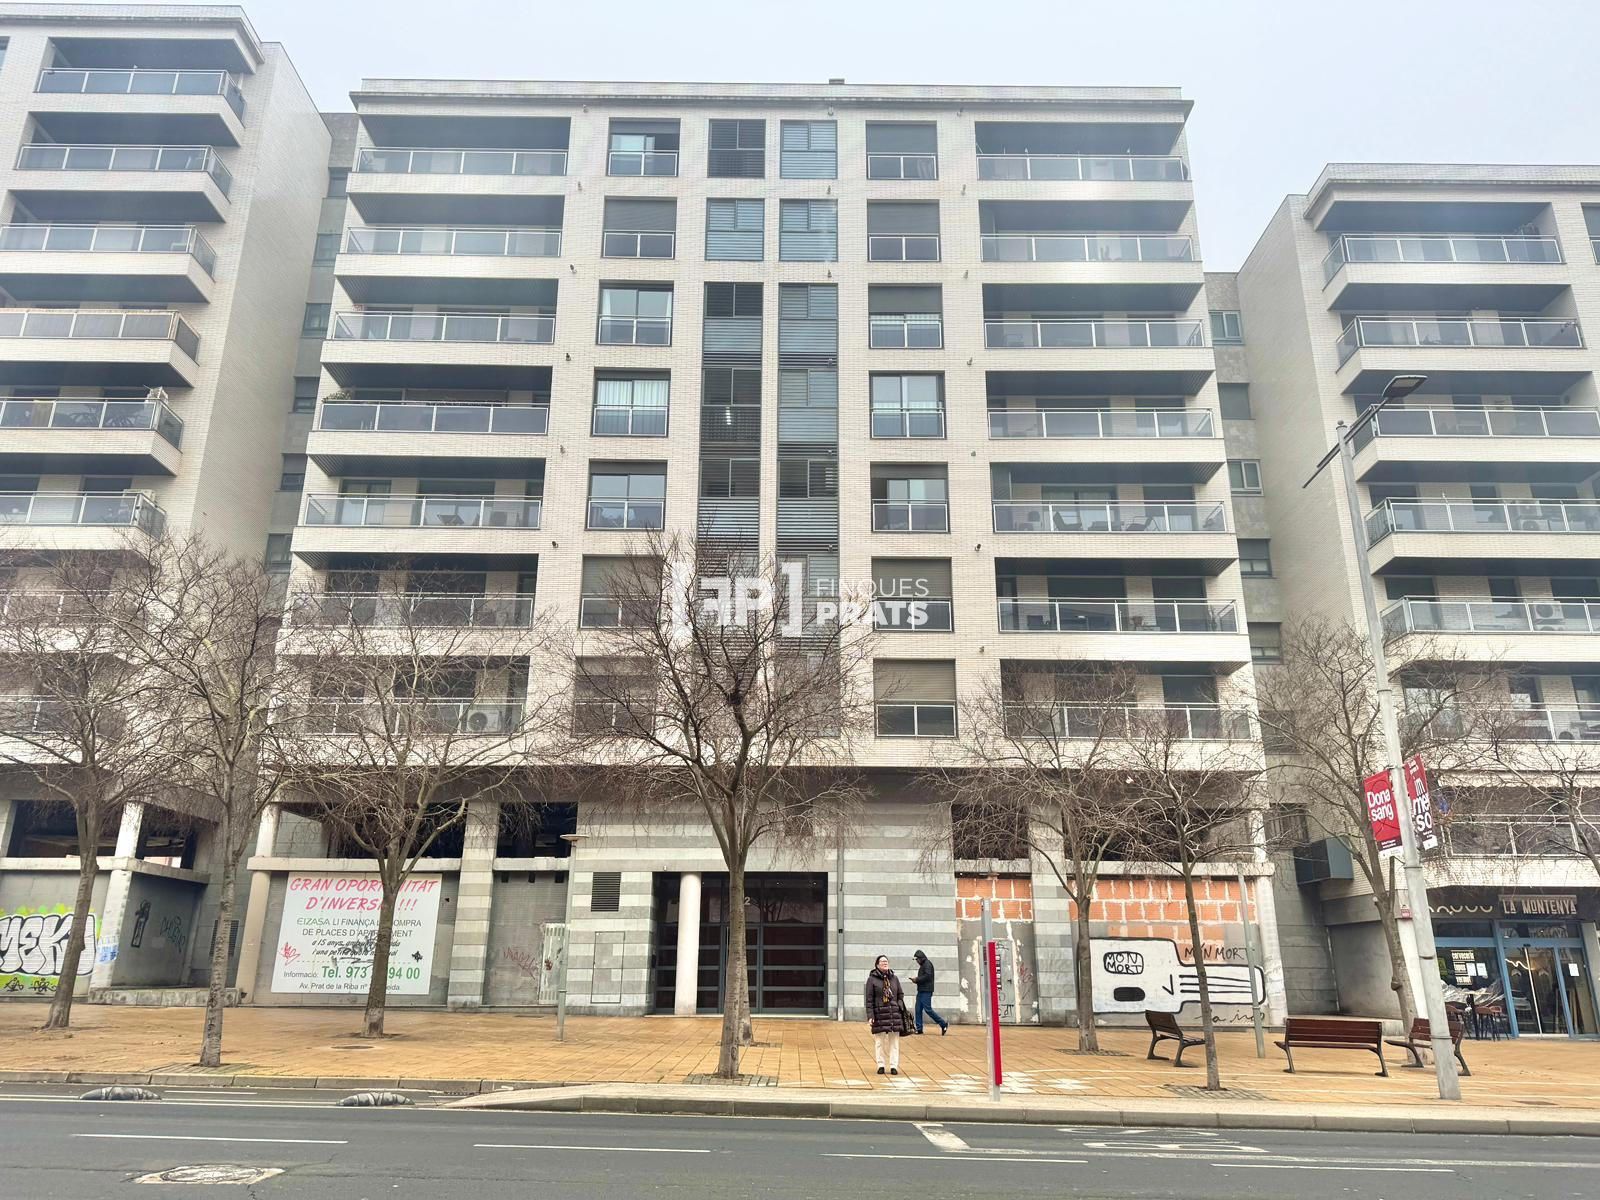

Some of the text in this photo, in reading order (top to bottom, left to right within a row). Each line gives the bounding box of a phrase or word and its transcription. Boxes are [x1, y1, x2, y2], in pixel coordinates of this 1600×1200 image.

[1366, 789, 1391, 808] Dona
[1371, 803, 1394, 822] sang
[290, 878, 439, 893] GRAN OPORTITAT
[1503, 899, 1577, 915] LA MONTENYA
[394, 919, 422, 927] OMPRA
[302, 928, 314, 936] DE
[315, 928, 347, 936] PLACES
[322, 966, 341, 978] Tel.
[346, 967, 367, 979] 973
[406, 967, 420, 979] 00
